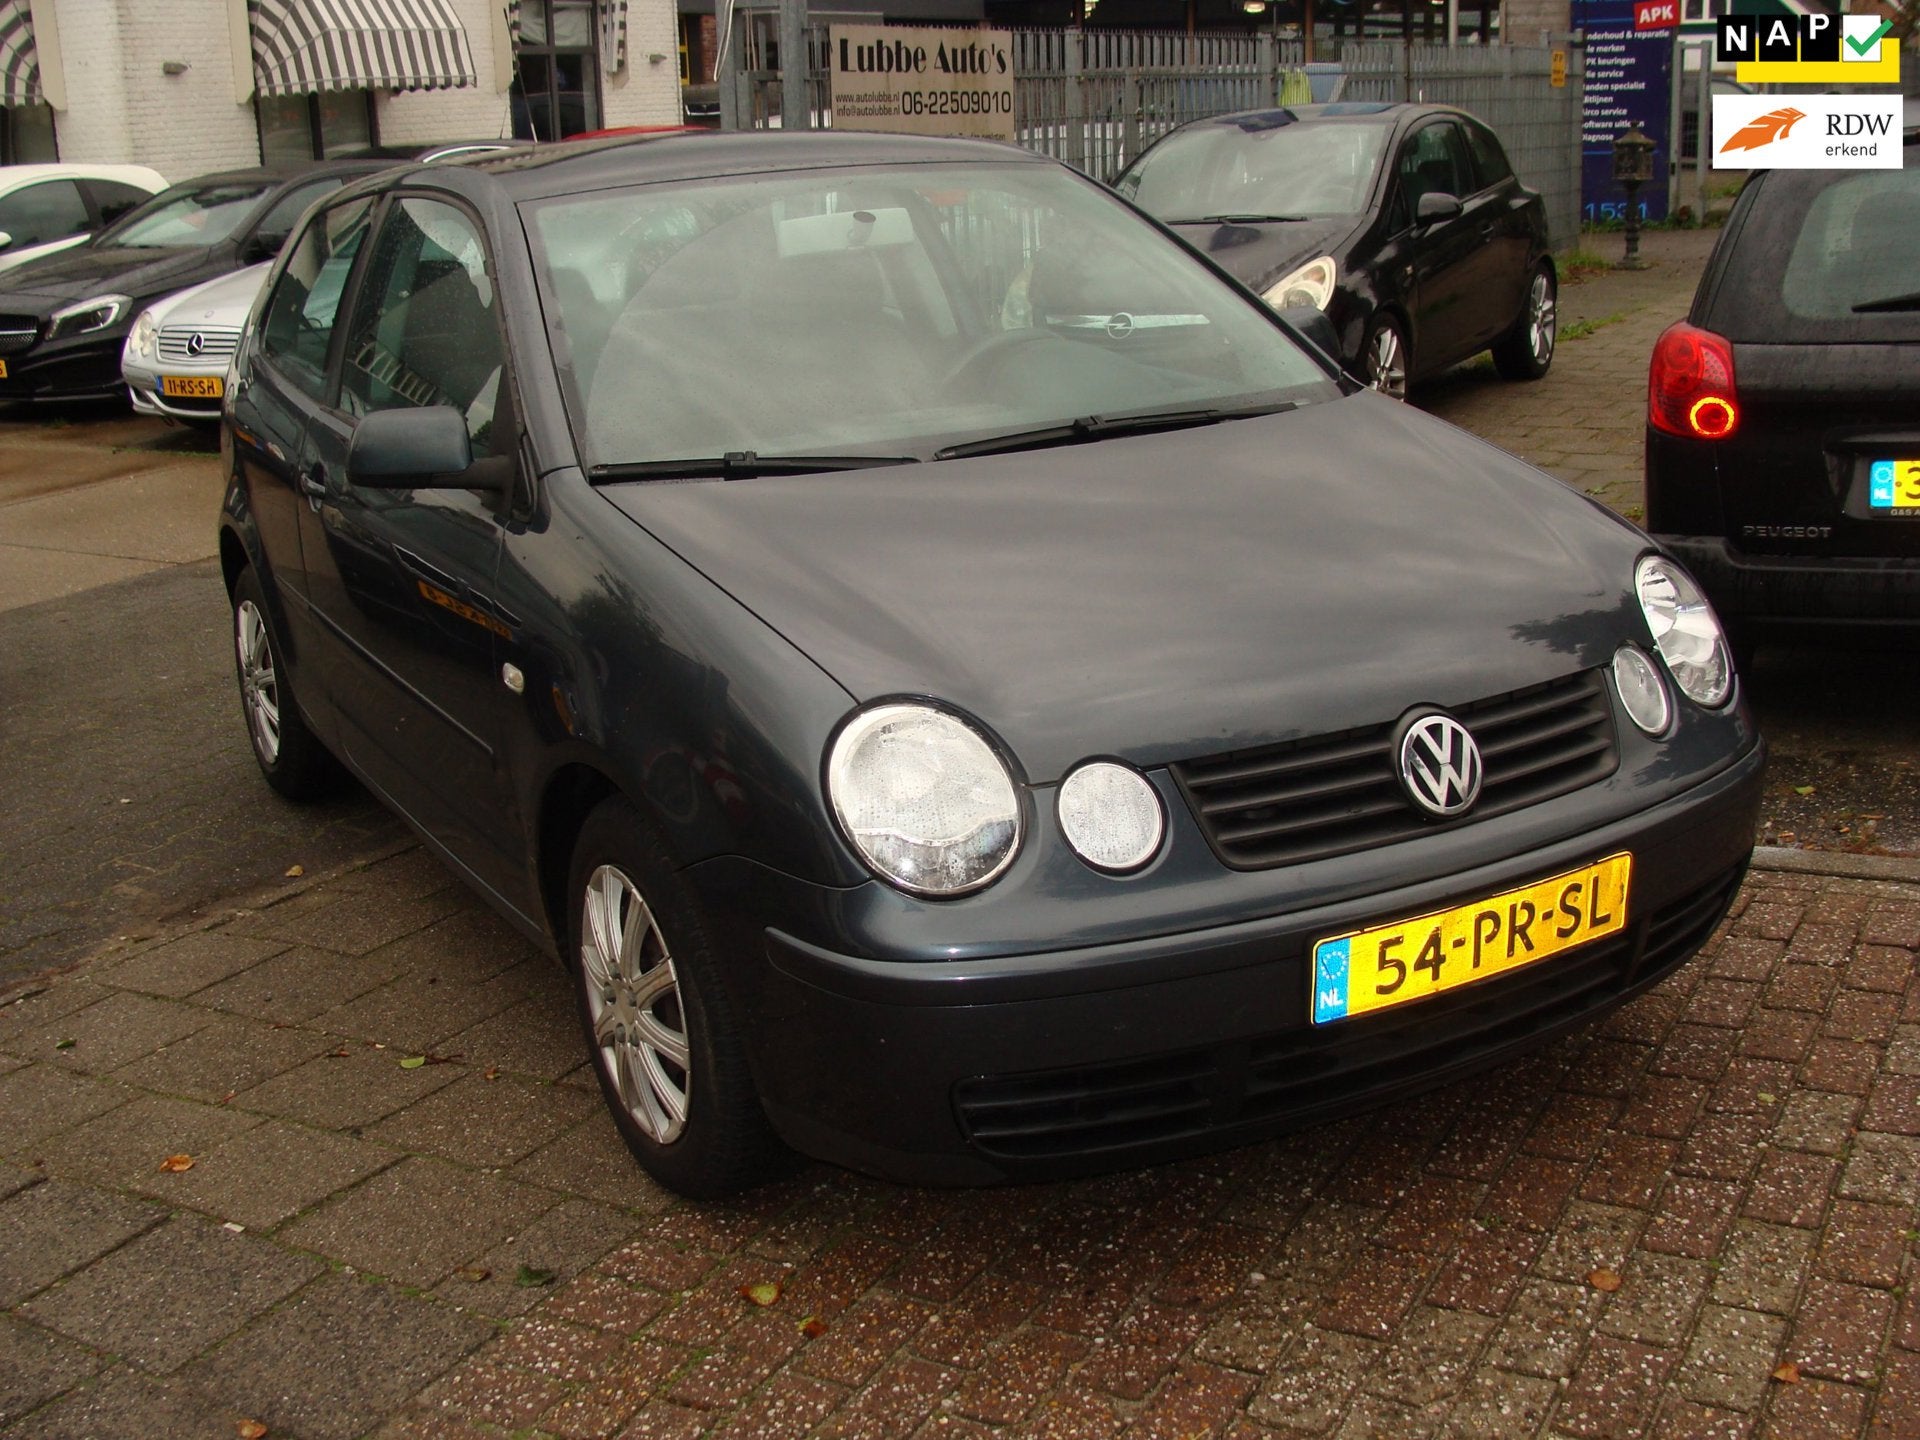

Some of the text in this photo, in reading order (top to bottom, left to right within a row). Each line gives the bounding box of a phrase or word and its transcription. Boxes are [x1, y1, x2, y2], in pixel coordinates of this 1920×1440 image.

[1639, 4, 1673, 24] APK
[1587, 29, 1670, 40] nderhoud & reparatie
[1596, 44, 1625, 53] merken
[839, 38, 1007, 74] Lubbe Auto's
[1586, 56, 1636, 67] PK keuringen
[1597, 69, 1624, 78] service
[1583, 81, 1646, 92] anden specialist
[836, 91, 900, 103] www.autolubbe.nl
[902, 91, 1012, 115] 06-22509010
[836, 104, 900, 117] info@autolubbe.nl
[1600, 107, 1627, 116] service
[1582, 120, 1613, 129] oftware
[168, 379, 216, 394] 11-RS-SH
[1873, 487, 1892, 500] NL
[1743, 525, 1832, 538] PEUGEOT
[1375, 875, 1611, 996] 54-PR-SL
[1320, 987, 1344, 1010] NL
